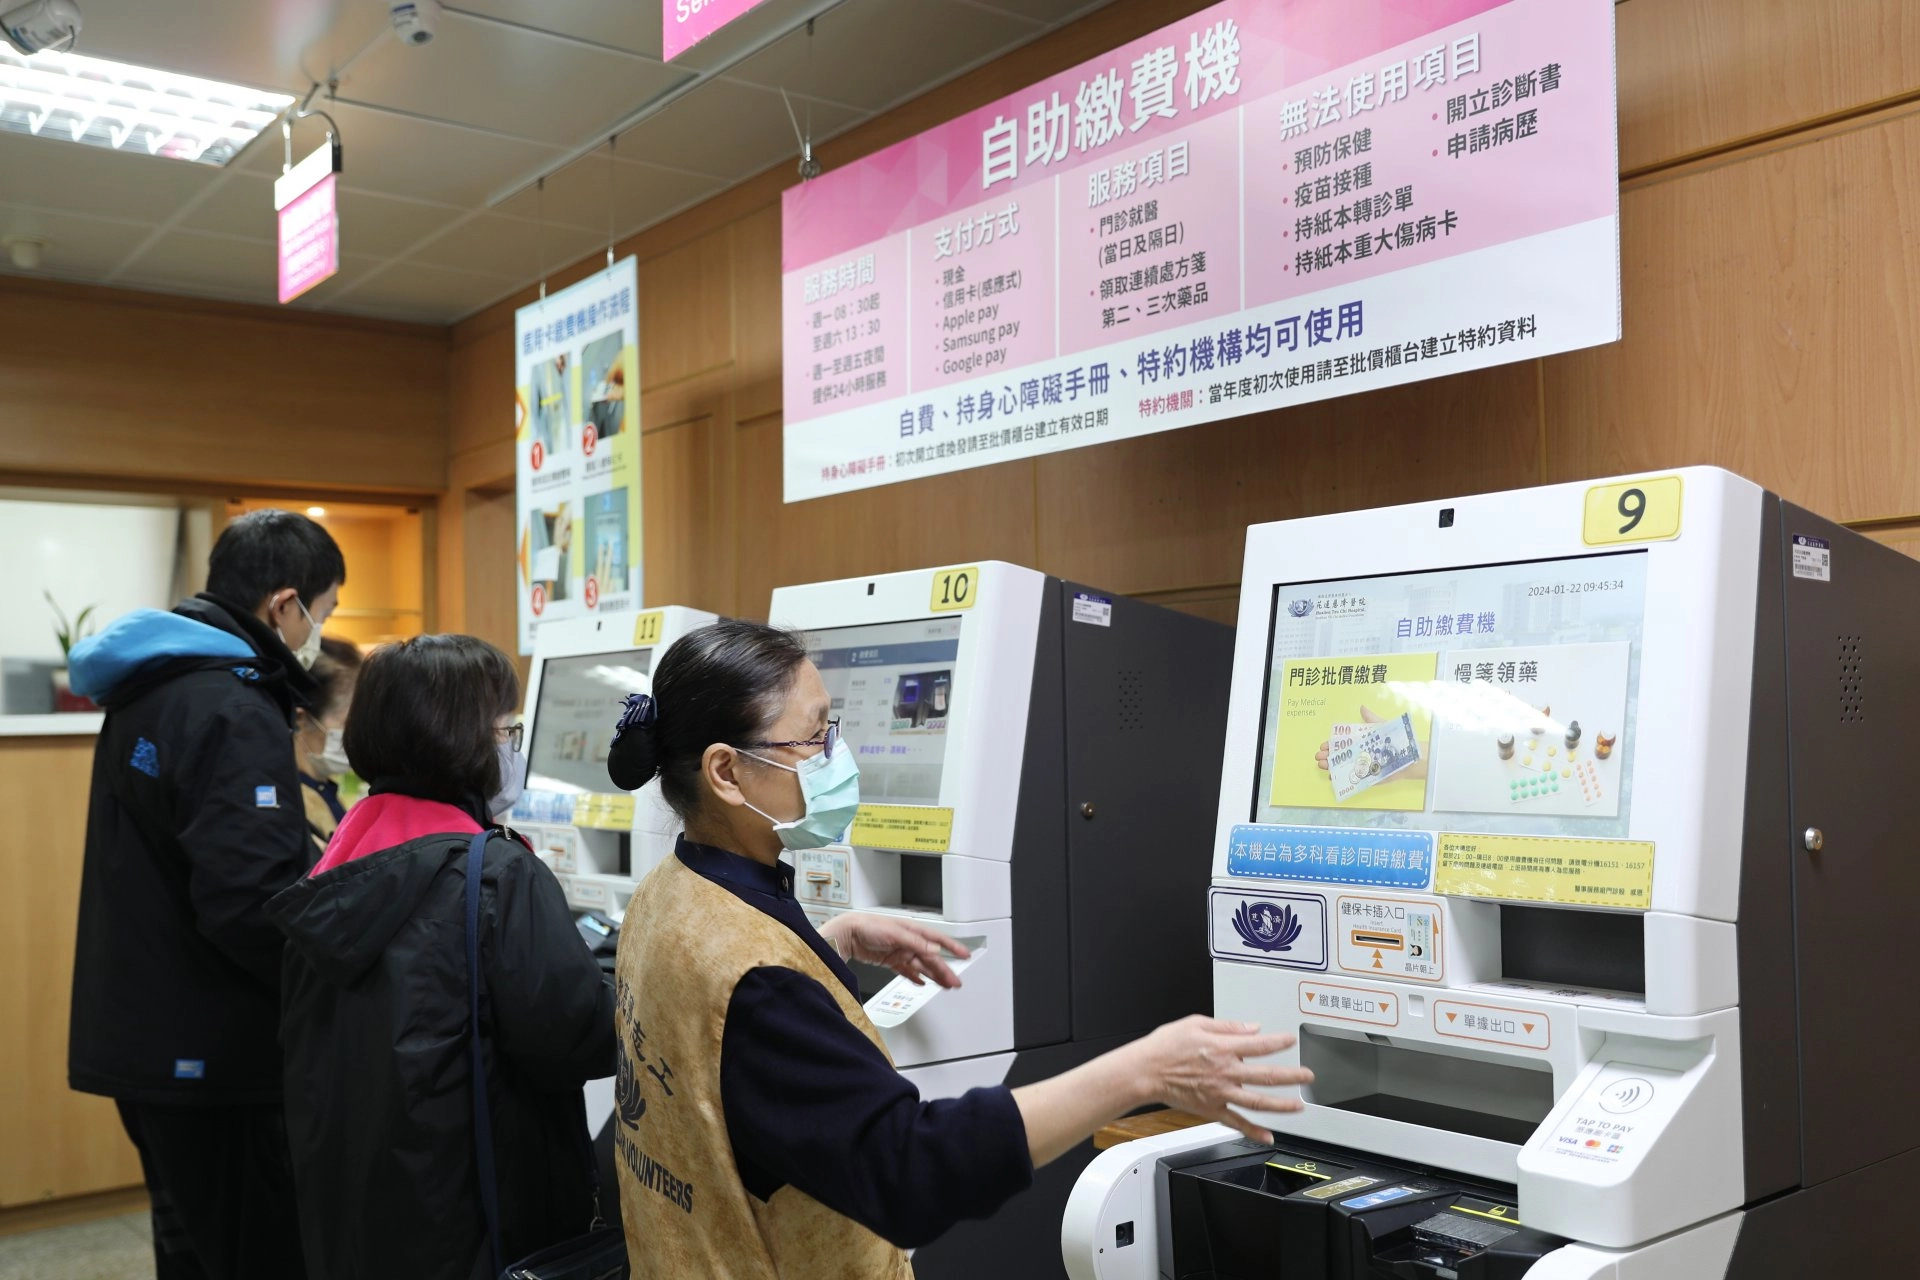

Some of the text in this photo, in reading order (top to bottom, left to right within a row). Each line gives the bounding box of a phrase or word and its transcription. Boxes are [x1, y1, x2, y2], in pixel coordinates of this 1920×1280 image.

[1279, 32, 1481, 141] 無法使用項目
[1446, 63, 1562, 126] 開立診斷書
[981, 18, 1241, 190] 自助繳費機
[1446, 108, 1539, 160] 申請病歷
[1293, 127, 1373, 176] 預防保健
[1087, 140, 1190, 208] 服務項目
[1293, 161, 1373, 209] 疫苗接種
[1099, 199, 1158, 238] 門診就醫
[1294, 184, 1414, 242] 持紙本轉診單
[933, 201, 1020, 262] 支付方式
[1098, 221, 1185, 269] (當日及隔日)
[1294, 209, 1458, 277] 持紙本重大傷病卡
[803, 252, 877, 304] 服務時間
[942, 264, 966, 287] 現金
[942, 269, 1022, 310] 信用卡(感應式)
[1100, 250, 1207, 301] 領取連續處方箋
[942, 303, 1000, 332] Apple pay
[1101, 281, 1208, 330] 第二、三次藥品
[943, 319, 1021, 353] Samsung pay
[899, 300, 1364, 439] 自費、持身心障礙手冊、特約機構均可使用
[942, 346, 1007, 375] Google pay
[812, 370, 887, 405] 提供24小時服務
[1617, 488, 1647, 535] 9
[941, 573, 970, 604] 10
[1528, 579, 1624, 598] 2024-01-22 09:45:34
[639, 620, 656, 640] 11
[1396, 611, 1497, 640] 自助繳費機
[1289, 663, 1388, 687] 門診批價繳費
[1454, 660, 1539, 685] 慢箋領藥
[1287, 698, 1326, 708] Pay Medical
[1333, 725, 1351, 735] 100
[1334, 738, 1353, 752] 500
[1331, 749, 1353, 767] 1000
[1233, 840, 1425, 871] 本機台為多科看診同時繳費
[1341, 901, 1405, 919] 健保卡插入口
[1404, 962, 1435, 975] 晶片朝上
[1319, 993, 1375, 1013] 繳費單出口
[1463, 1013, 1515, 1034] 單據出口
[1558, 1136, 1578, 1145] VISA
[1576, 1117, 1635, 1133] TAP TO PAY
[626, 1137, 694, 1214] VOLUNTEERS
